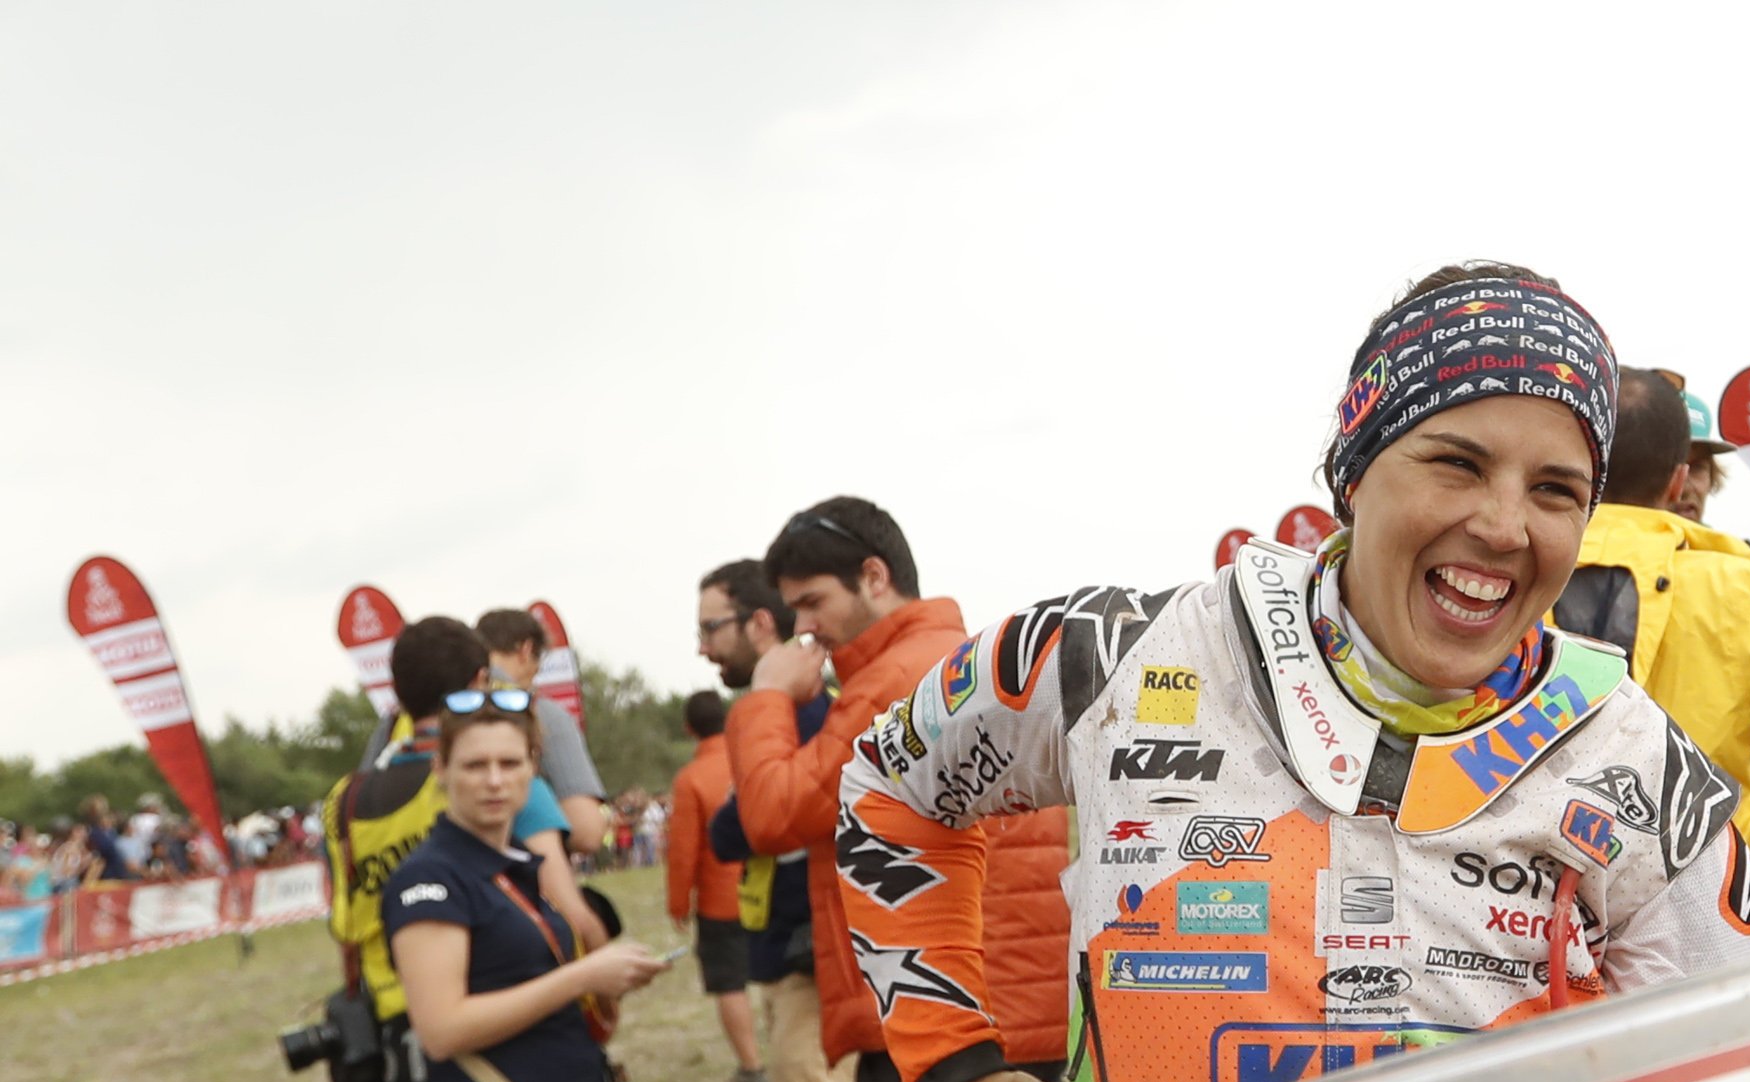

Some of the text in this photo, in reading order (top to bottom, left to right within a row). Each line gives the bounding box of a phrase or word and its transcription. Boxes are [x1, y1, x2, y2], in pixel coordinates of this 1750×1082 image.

[1434, 291, 1475, 310] Red
[1478, 288, 1523, 301] Bull
[1431, 316, 1525, 344] Red Bull
[1521, 303, 1598, 348] Red Bull
[1397, 351, 1435, 382] Bull
[1437, 354, 1526, 382] Red Bull
[1518, 334, 1563, 358] Red
[1565, 348, 1598, 381] Bull
[1518, 376, 1590, 419] Red Bull
[1379, 391, 1440, 440] Red Bull
[1144, 670, 1197, 692] RACC
[1291, 681, 1341, 751] xerox
[1109, 738, 1226, 782] KTM
[1100, 847, 1167, 865] LAIKA
[1181, 903, 1260, 919] MOTOREX
[1322, 935, 1411, 950] SEAT
[1138, 964, 1252, 981] MICHELIN
[1334, 964, 1400, 986] ARC
[1427, 949, 1529, 978] MADFORM
[1349, 983, 1401, 1005] Racing
